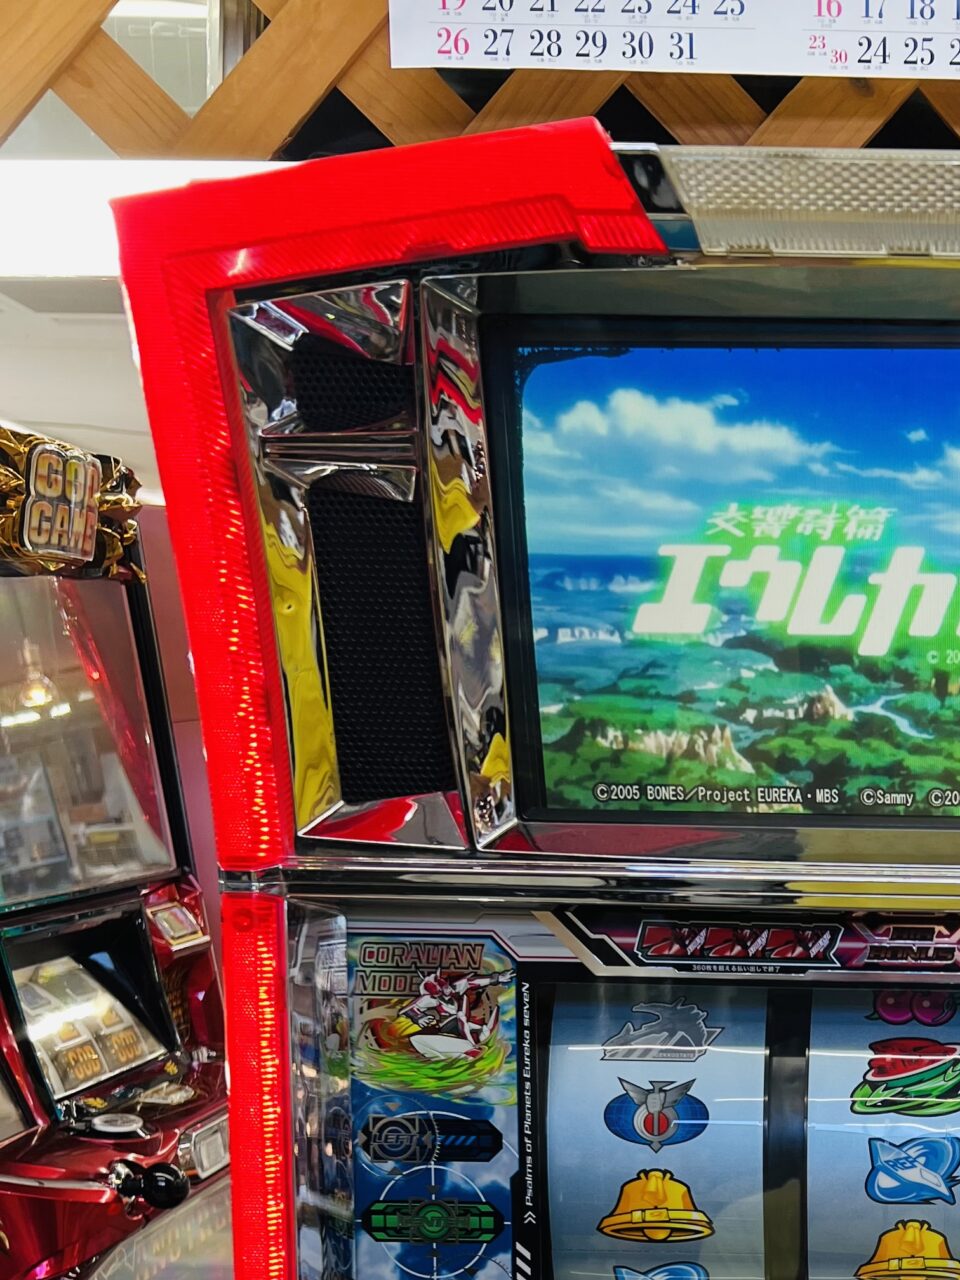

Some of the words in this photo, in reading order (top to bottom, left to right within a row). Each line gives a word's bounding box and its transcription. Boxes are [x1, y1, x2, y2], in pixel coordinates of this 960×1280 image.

[437, 27, 470, 56] 26
[483, 28, 515, 56] 27
[529, 29, 562, 57] 28
[575, 30, 607, 58] 29
[622, 31, 654, 59] 30
[669, 32, 698, 60] 31
[808, 34, 826, 50] 23
[830, 50, 848, 64] 30
[857, 36, 891, 65] 24
[904, 37, 936, 66] 25
[705, 502, 897, 542] 交響詩篇
[361, 942, 485, 970] CORALIAN
[522, 1031, 531, 1078] Eureka
[523, 1081, 532, 1134] Planets
[525, 1137, 532, 1148] of
[525, 1154, 533, 1206] Psalms
